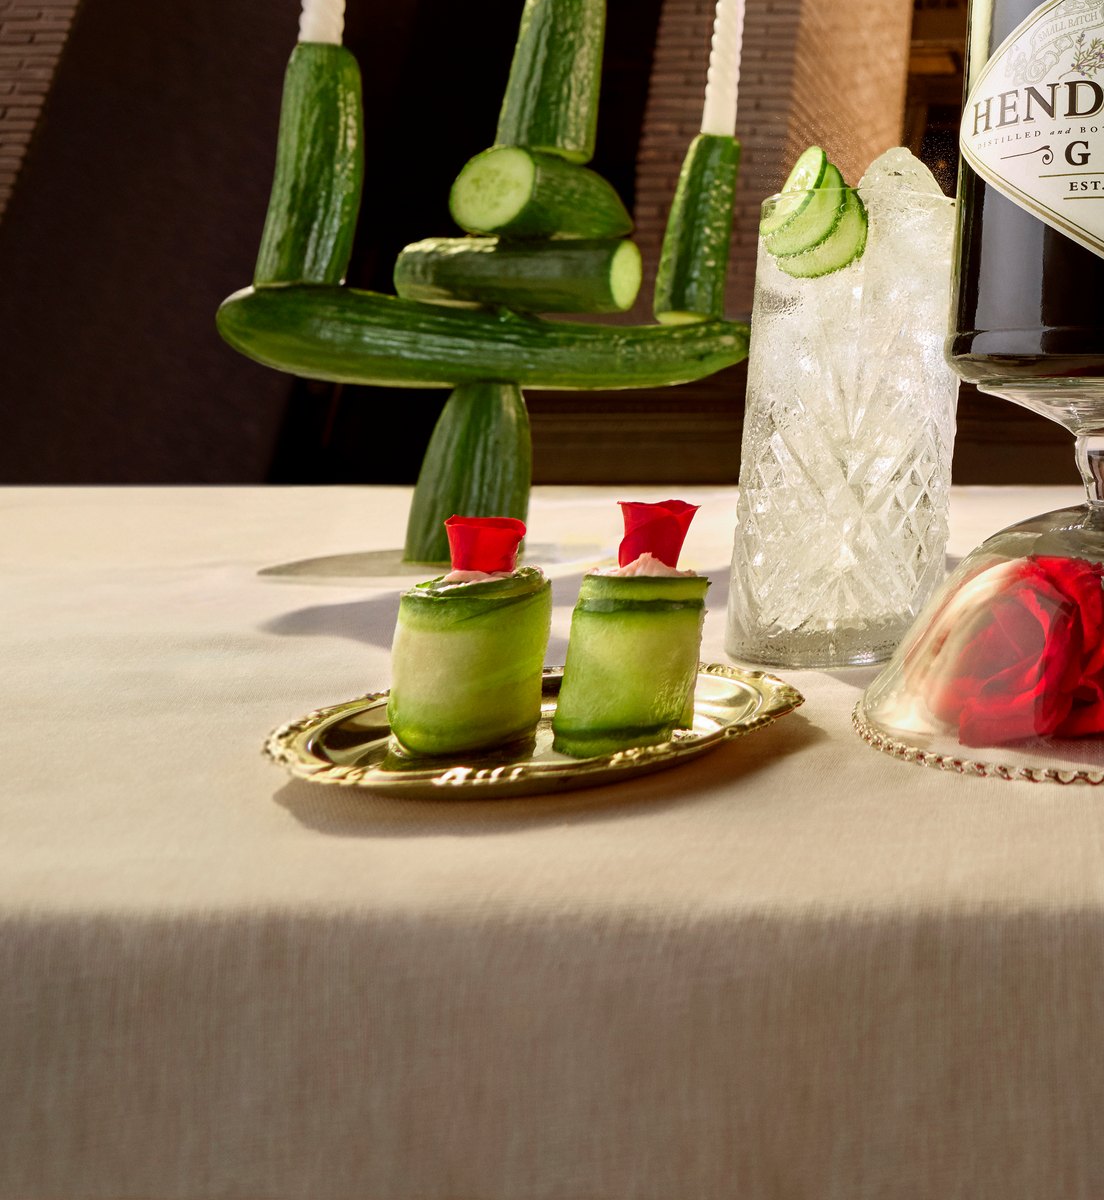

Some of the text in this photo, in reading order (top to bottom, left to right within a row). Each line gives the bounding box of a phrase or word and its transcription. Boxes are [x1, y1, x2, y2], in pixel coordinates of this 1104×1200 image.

[1037, 11, 1098, 43] SMALL BATCH
[977, 130, 1042, 150] DISTILLED
[1050, 127, 1072, 135] and
